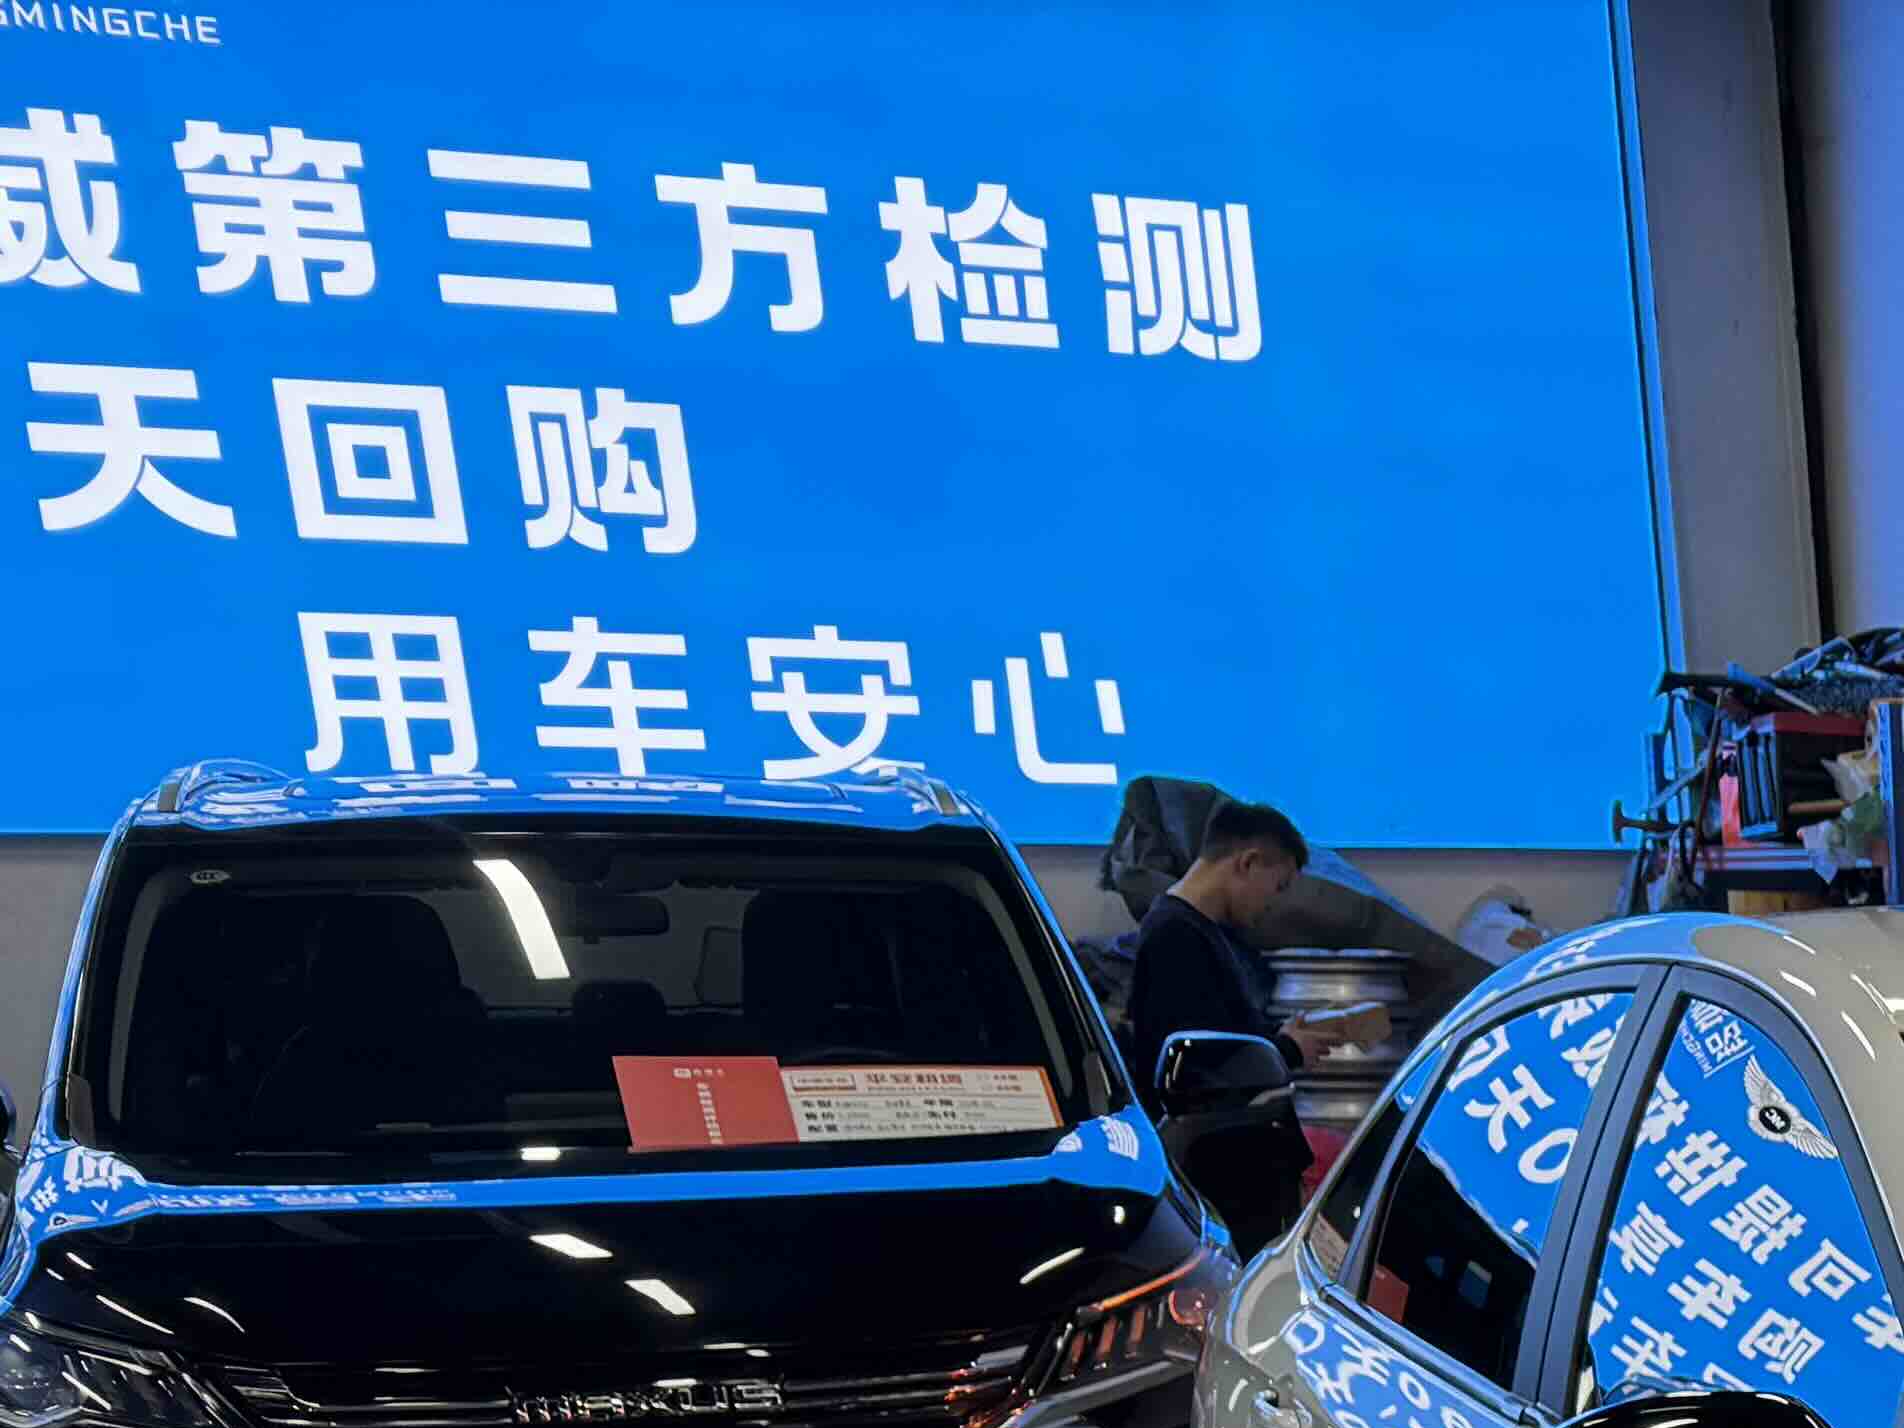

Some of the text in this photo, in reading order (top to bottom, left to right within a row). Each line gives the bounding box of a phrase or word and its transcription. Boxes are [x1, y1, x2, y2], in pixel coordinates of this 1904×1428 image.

[0, 0, 221, 44] MINGCHE
[26, 361, 698, 555] 天回购
[296, 611, 1126, 785] 用车安心
